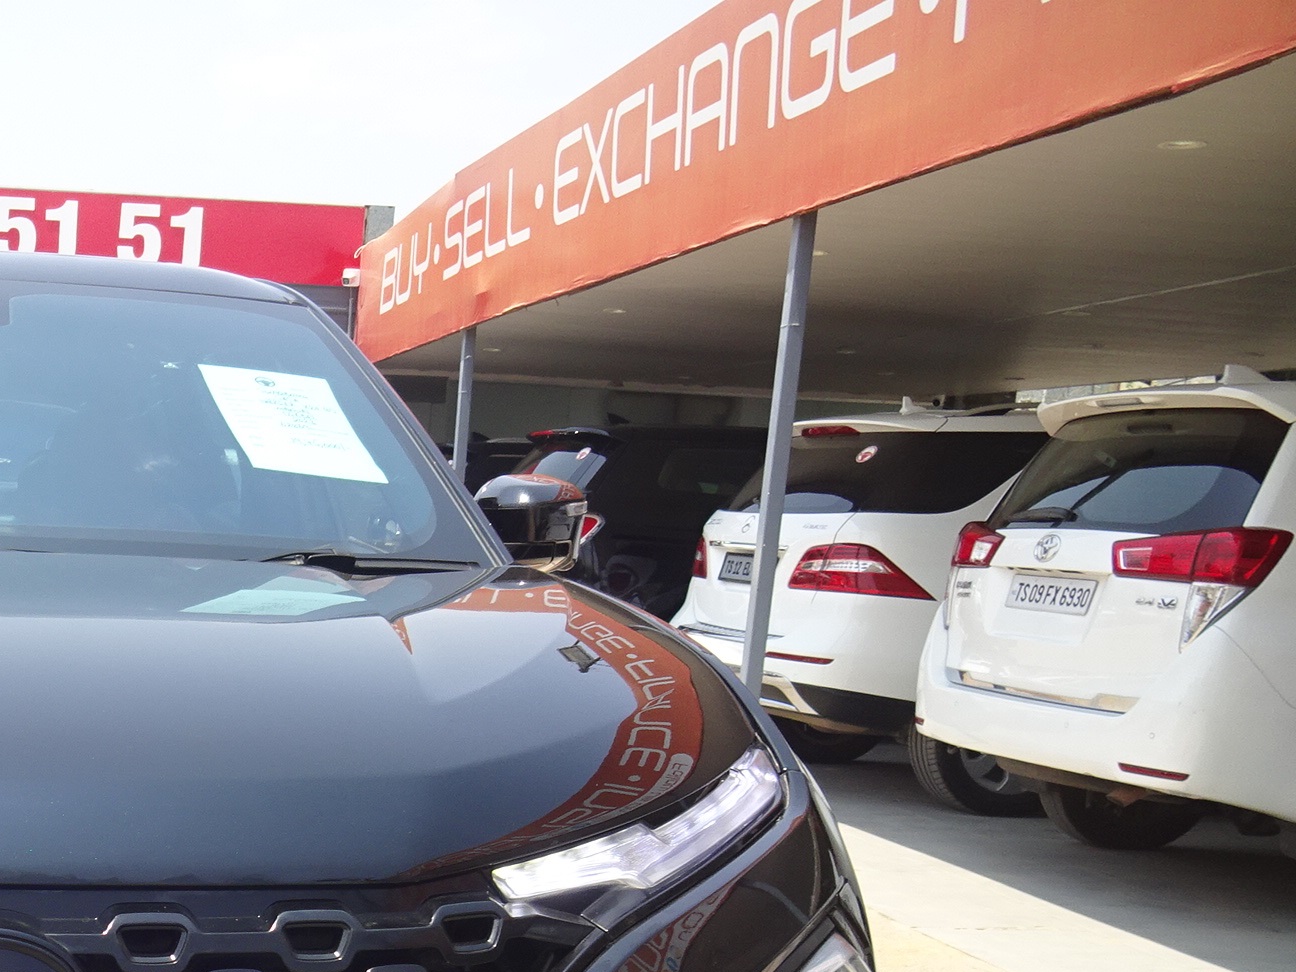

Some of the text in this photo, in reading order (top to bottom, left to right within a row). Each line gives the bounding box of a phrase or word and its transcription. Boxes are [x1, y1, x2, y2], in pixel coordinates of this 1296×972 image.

[116, 202, 204, 267] 51
[379, 0, 896, 315] BUY SELL EXCHANGE
